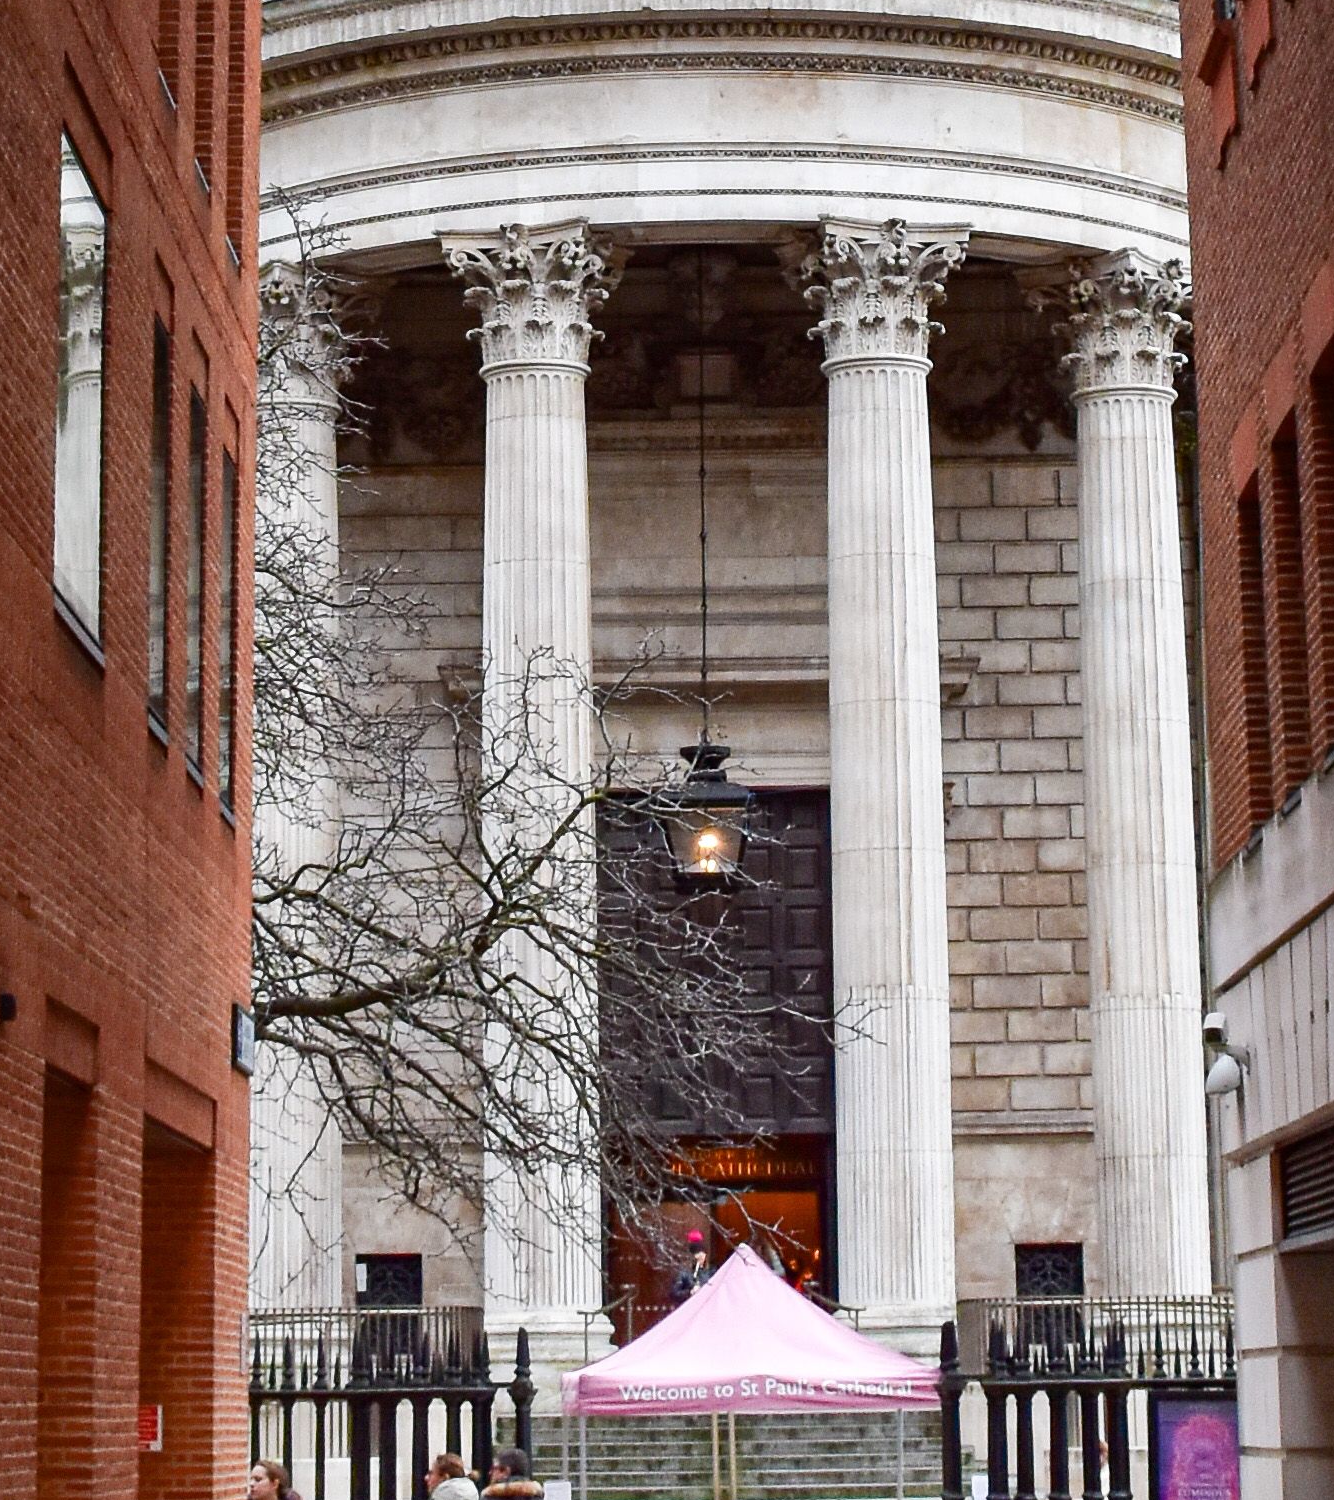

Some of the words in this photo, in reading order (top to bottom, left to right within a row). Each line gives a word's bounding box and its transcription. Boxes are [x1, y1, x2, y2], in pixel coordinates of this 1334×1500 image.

[618, 1383, 708, 1401] Welcome
[714, 1384, 734, 1398] to
[740, 1379, 760, 1396] St
[765, 1377, 815, 1396] Paul's
[822, 1379, 913, 1396] Cathedral
